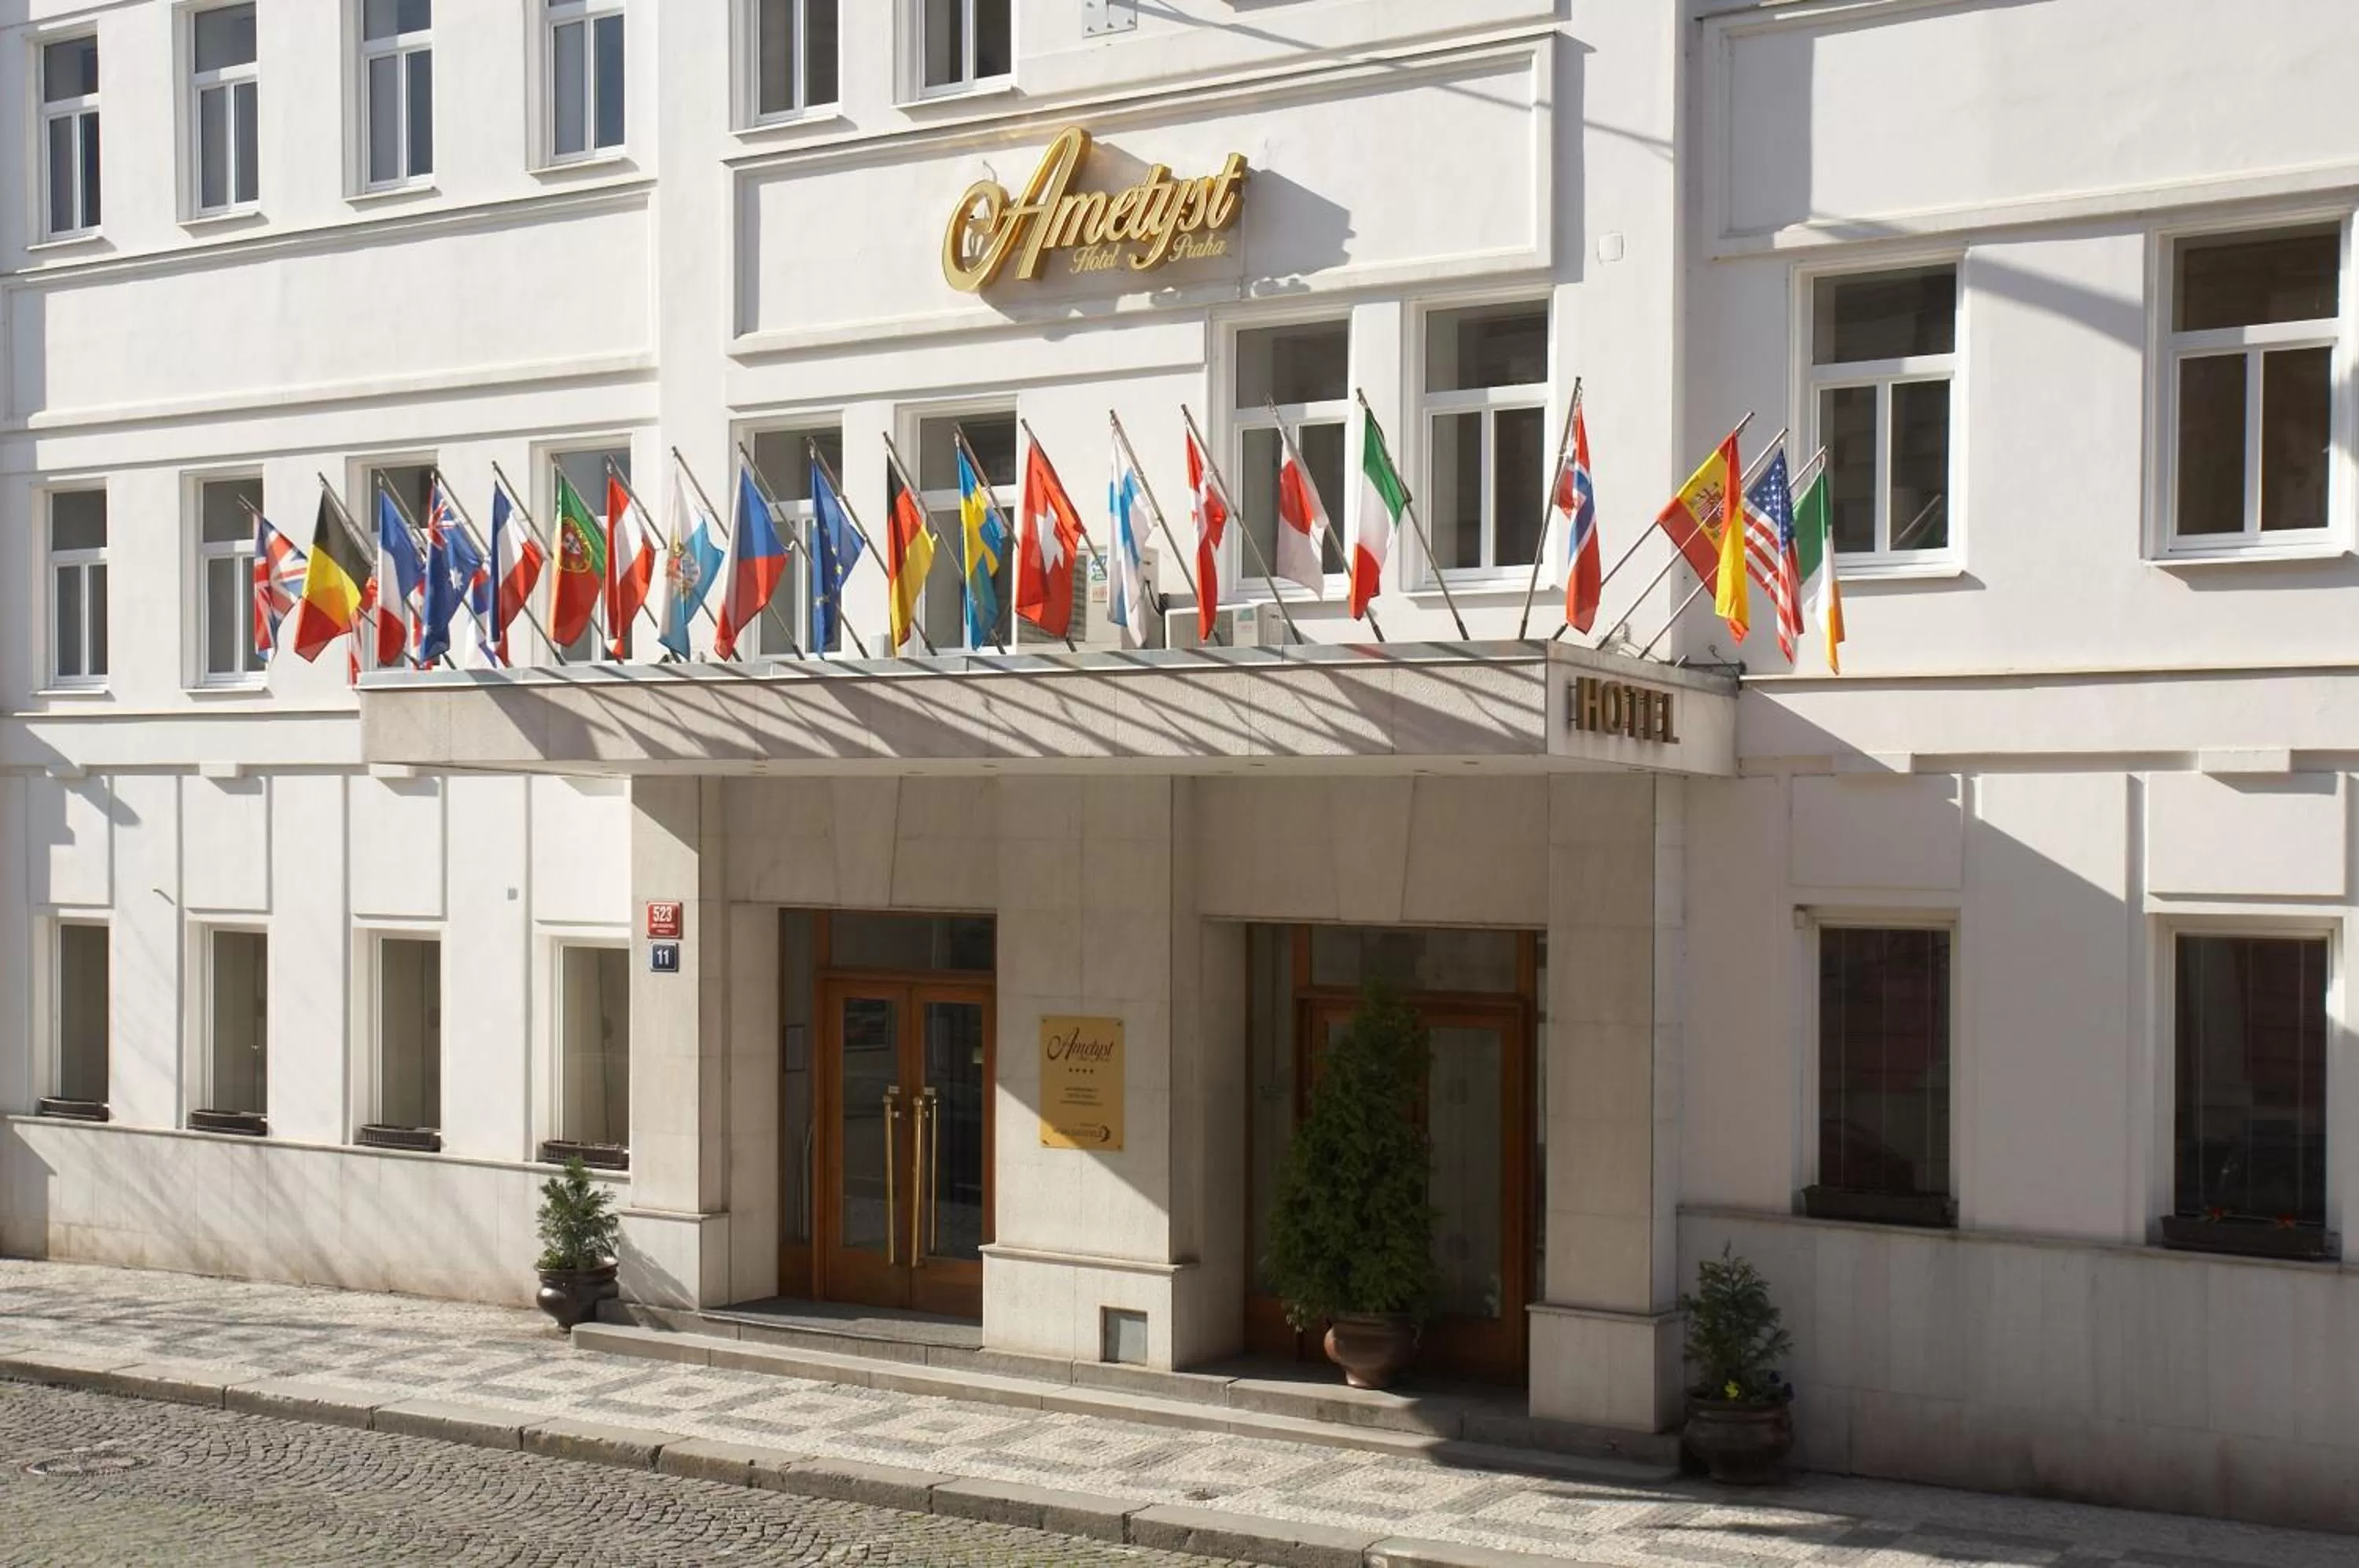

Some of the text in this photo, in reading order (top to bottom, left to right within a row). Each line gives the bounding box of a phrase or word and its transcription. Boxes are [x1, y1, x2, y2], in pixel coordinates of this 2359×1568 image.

[942, 126, 1248, 293] Ametyst
[1069, 233, 1227, 274] Hotel Praha
[1576, 677, 1680, 744] HOTEL
[653, 905, 672, 922] 523
[657, 949, 669, 965] 11
